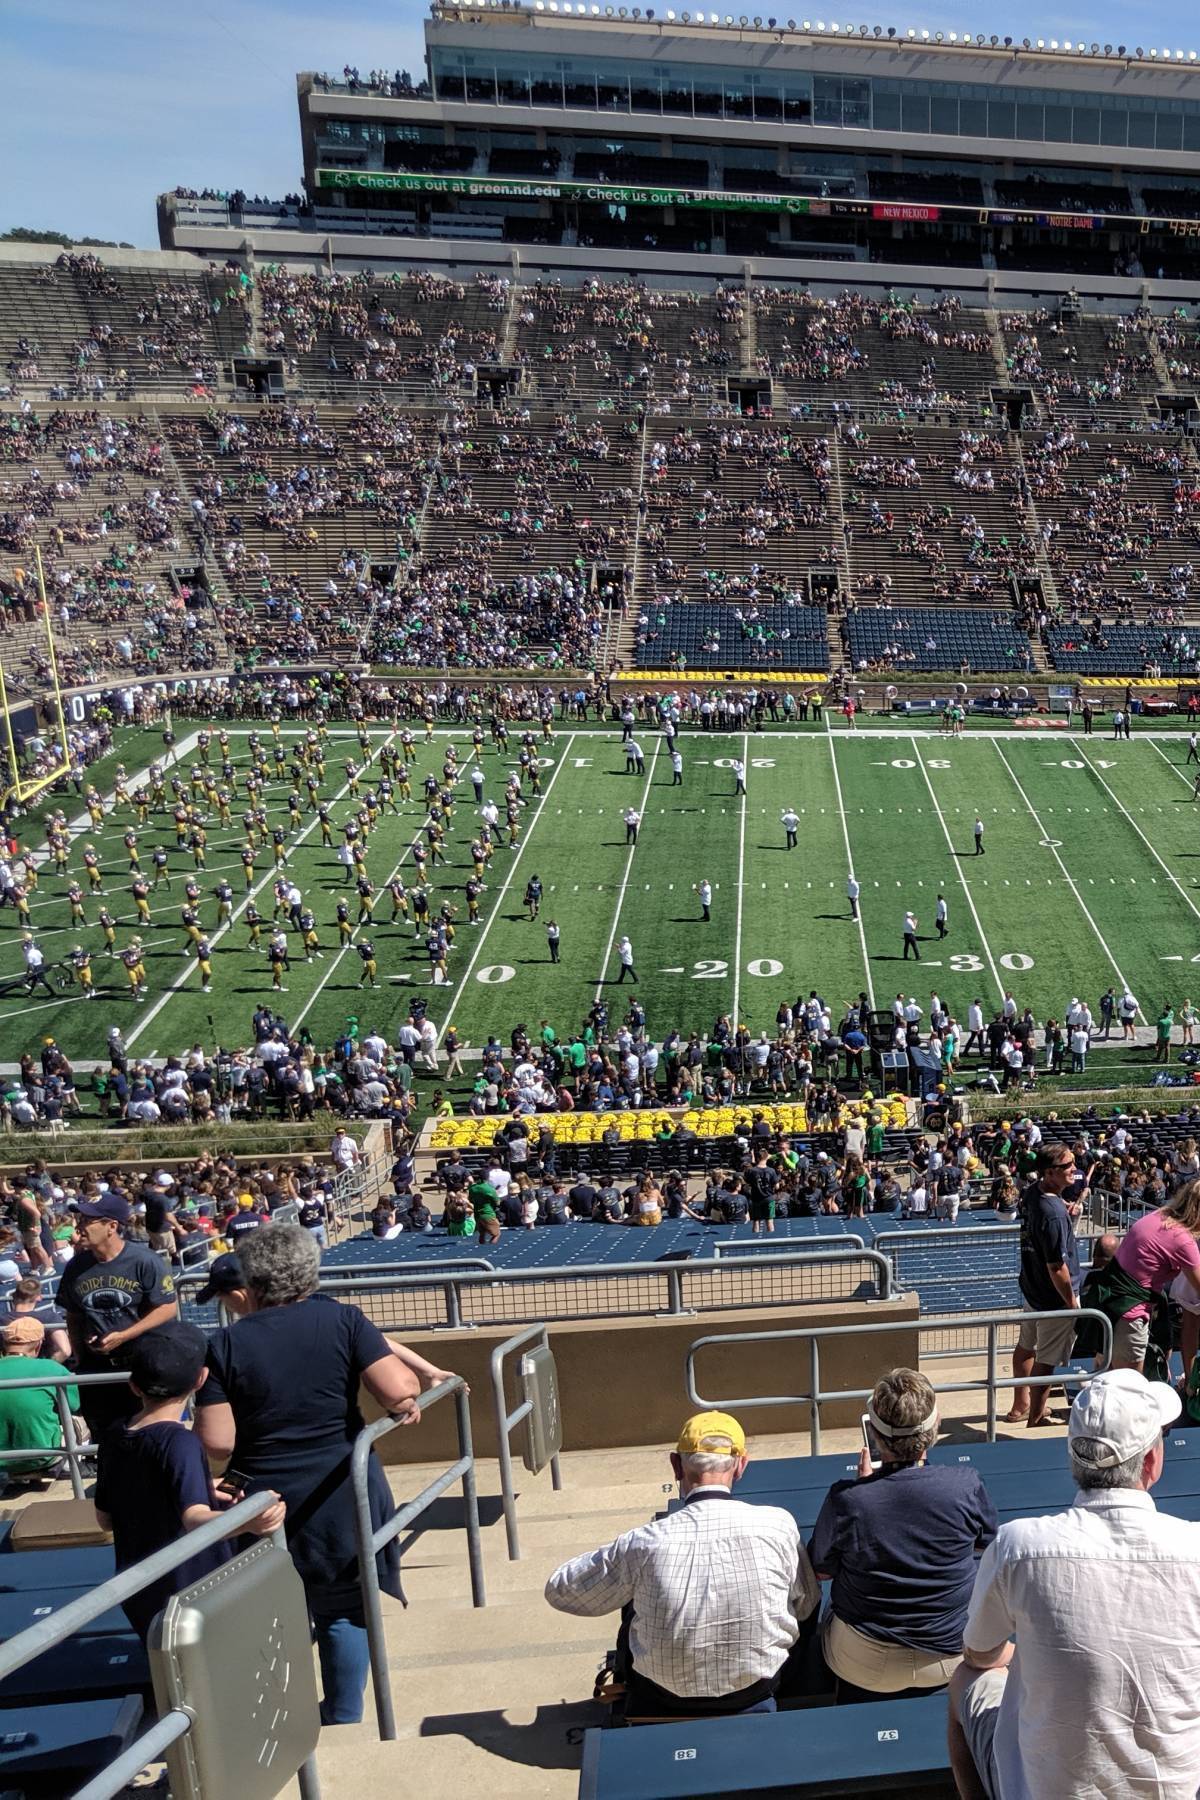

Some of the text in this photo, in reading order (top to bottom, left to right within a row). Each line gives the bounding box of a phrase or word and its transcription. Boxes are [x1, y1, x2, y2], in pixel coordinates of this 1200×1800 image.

[357, 175, 560, 198] Check us out at green.nd.edu
[587, 188, 628, 201] Check
[633, 191, 647, 202] us
[651, 192, 673, 203] out
[677, 193, 690, 204] at
[883, 206, 929, 220] NEW MEXICO
[1049, 216, 1094, 229] NOTRE DAME
[691, 959, 784, 979] 20
[950, 953, 1034, 971] 30
[109, 1275, 141, 1292] DAME
[879, 1730, 898, 1740] 37
[676, 1749, 696, 1759] 38
